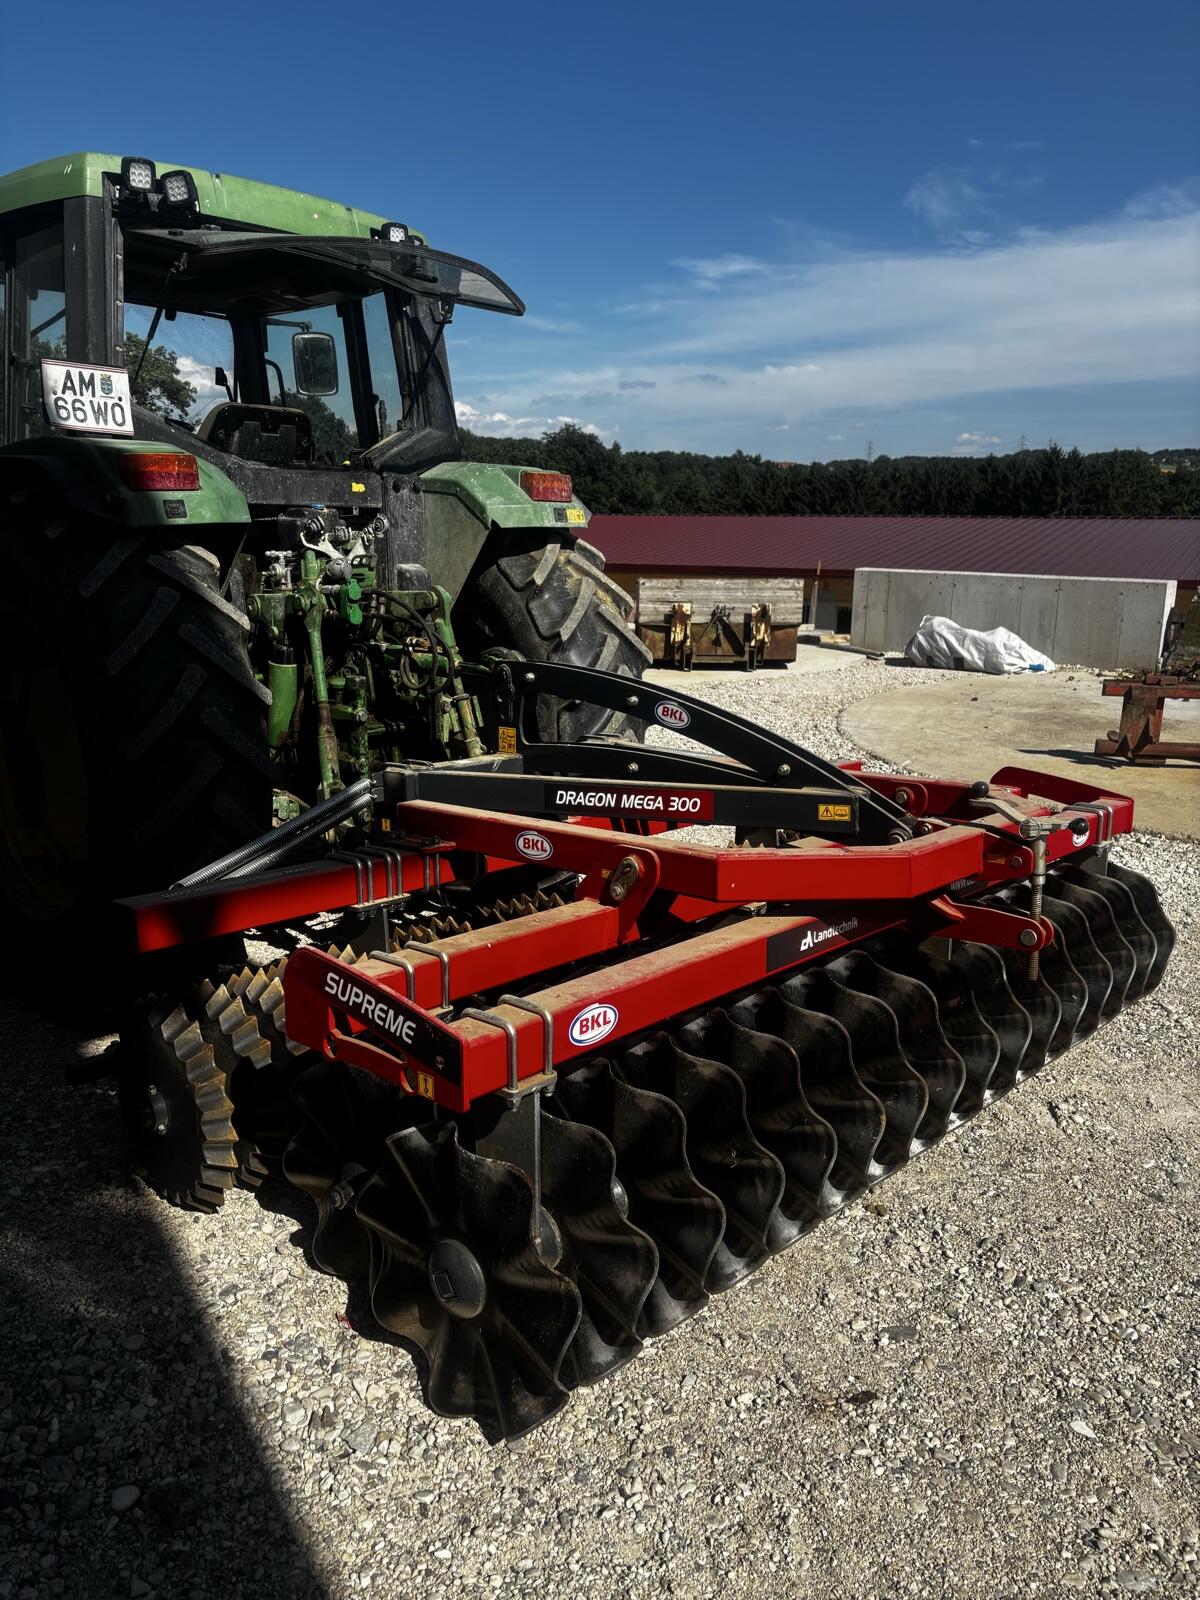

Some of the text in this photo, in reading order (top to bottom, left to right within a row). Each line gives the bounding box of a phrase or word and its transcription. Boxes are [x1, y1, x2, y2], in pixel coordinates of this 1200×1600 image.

[62, 369, 96, 398] AM
[661, 705, 685, 723] BKL
[555, 790, 701, 813] DRAGON MEGA 300
[522, 837, 548, 853] BKL
[813, 916, 859, 944] Landtechnik
[324, 971, 417, 1045] SUPREME
[579, 1009, 612, 1036] BKL
